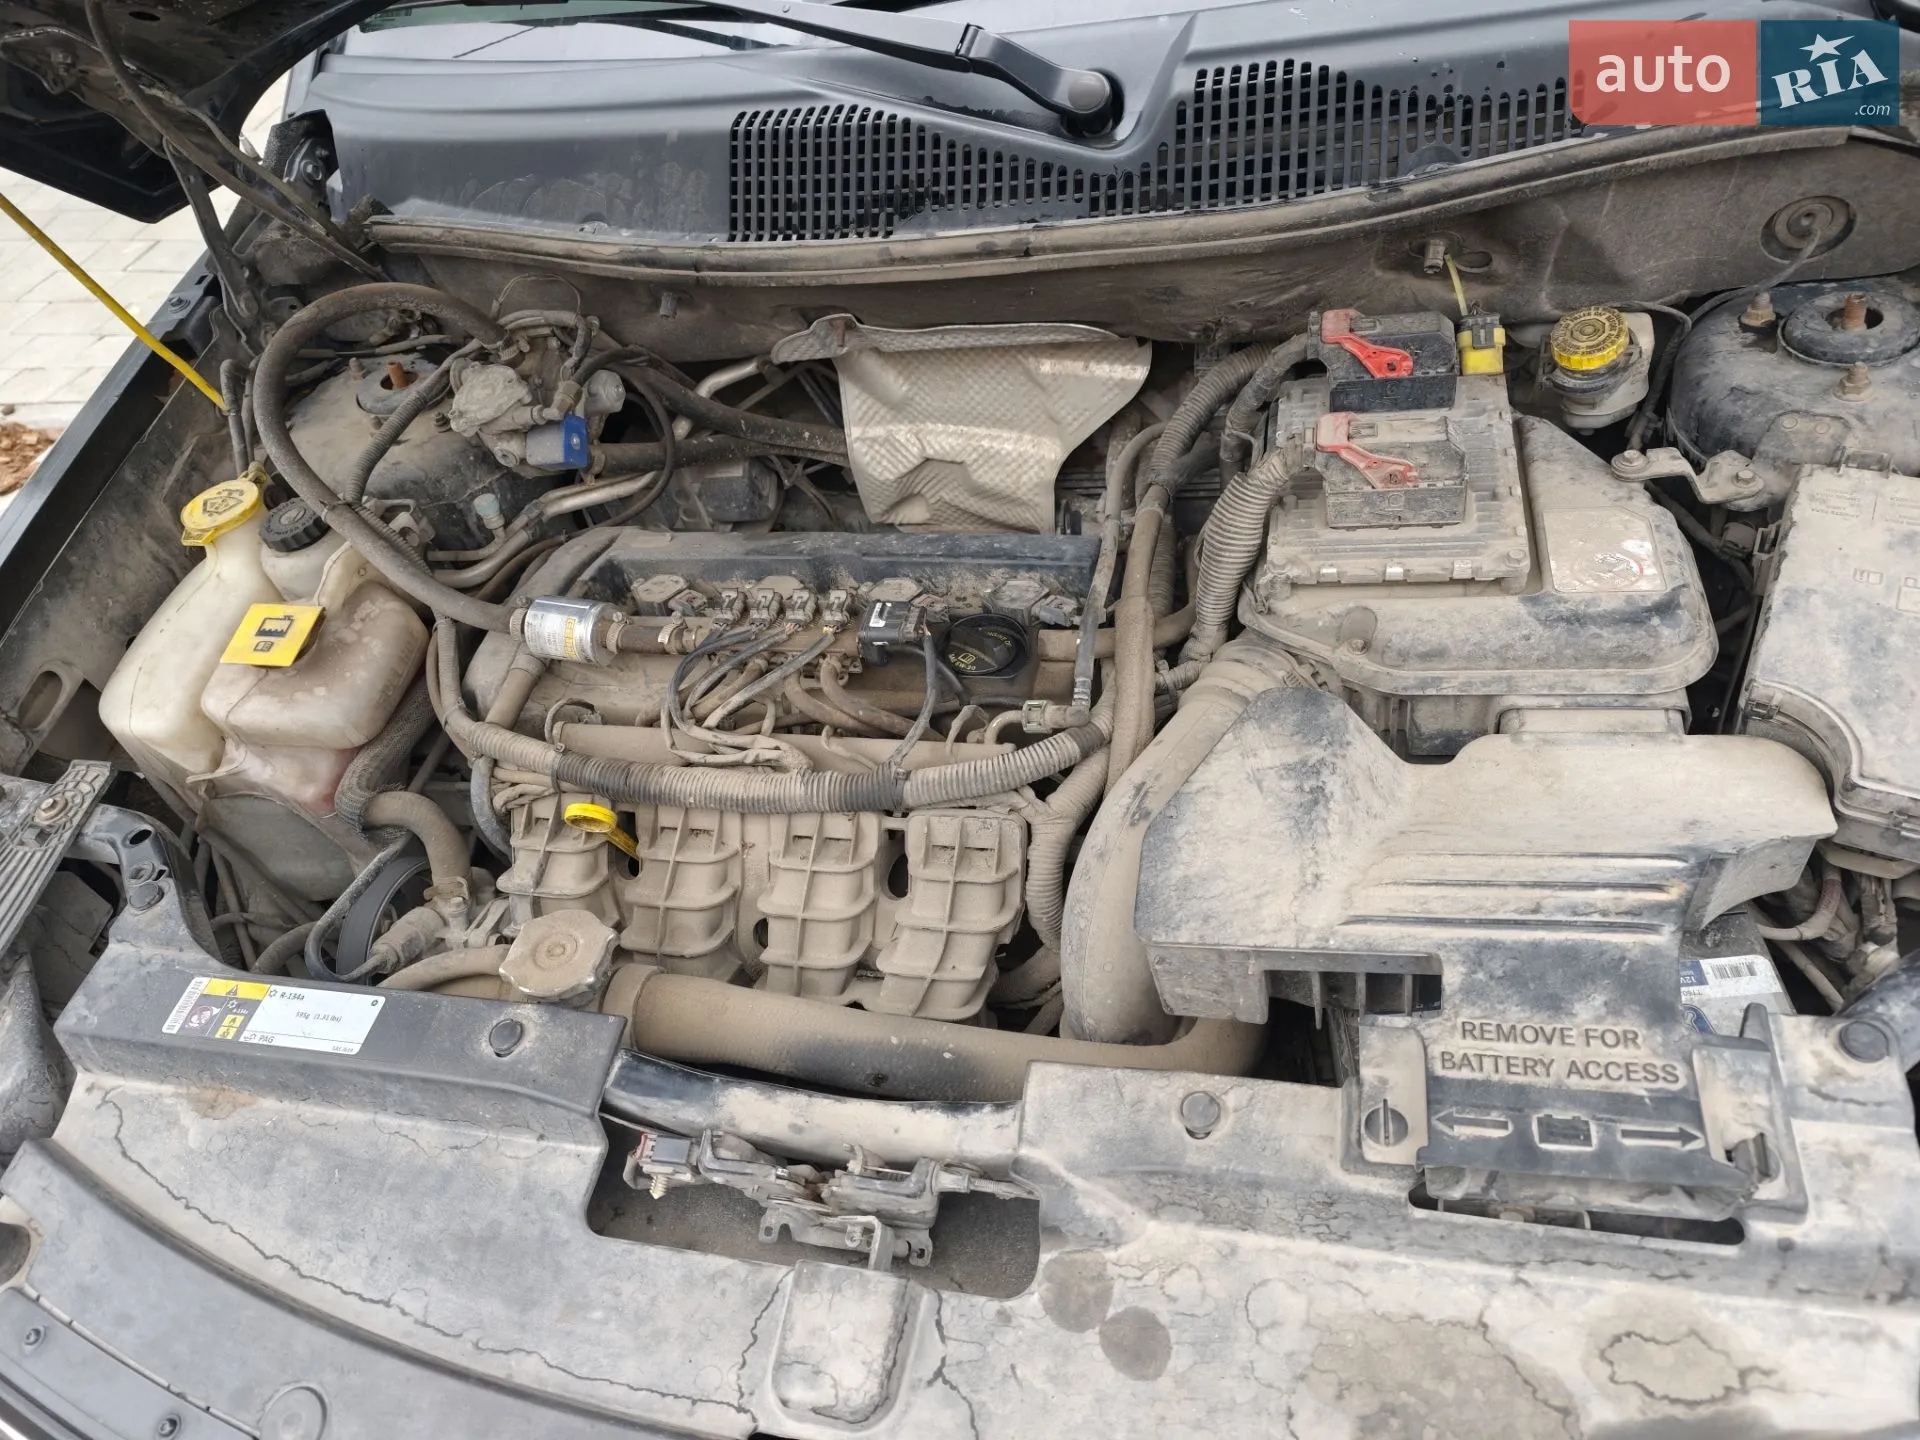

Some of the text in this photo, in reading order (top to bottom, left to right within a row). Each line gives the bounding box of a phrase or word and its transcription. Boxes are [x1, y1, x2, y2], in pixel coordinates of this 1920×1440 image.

[280, 991, 305, 1001] R-134a
[258, 1035, 275, 1044] PAG
[1460, 1020, 1642, 1051] REMOVE FOR
[1440, 1050, 1680, 1085] BATTERY ACCESS
